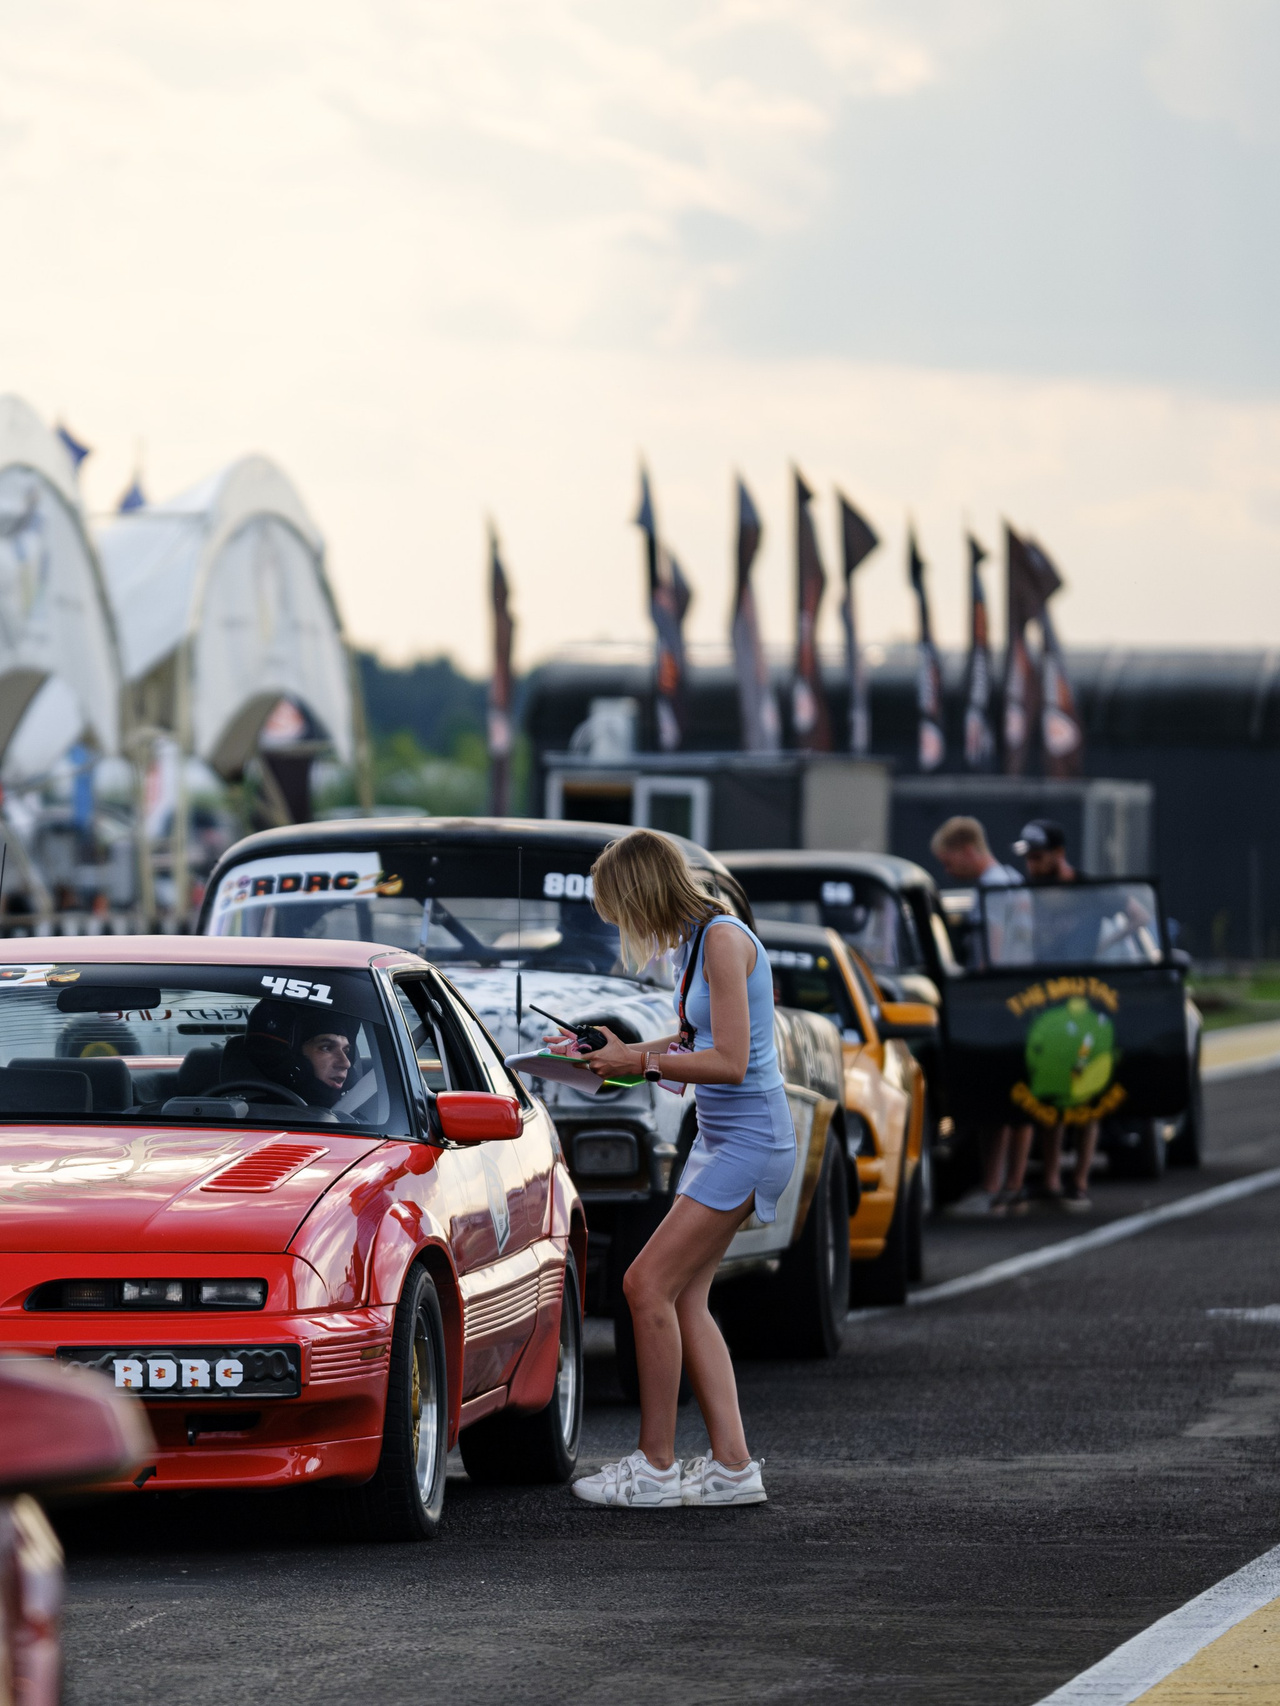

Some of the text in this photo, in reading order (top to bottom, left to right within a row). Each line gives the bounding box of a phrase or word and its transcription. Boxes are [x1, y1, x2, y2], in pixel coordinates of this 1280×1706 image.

[251, 871, 359, 896] RDRC
[261, 975, 333, 1004] 451
[113, 1359, 243, 1387] RDRC
